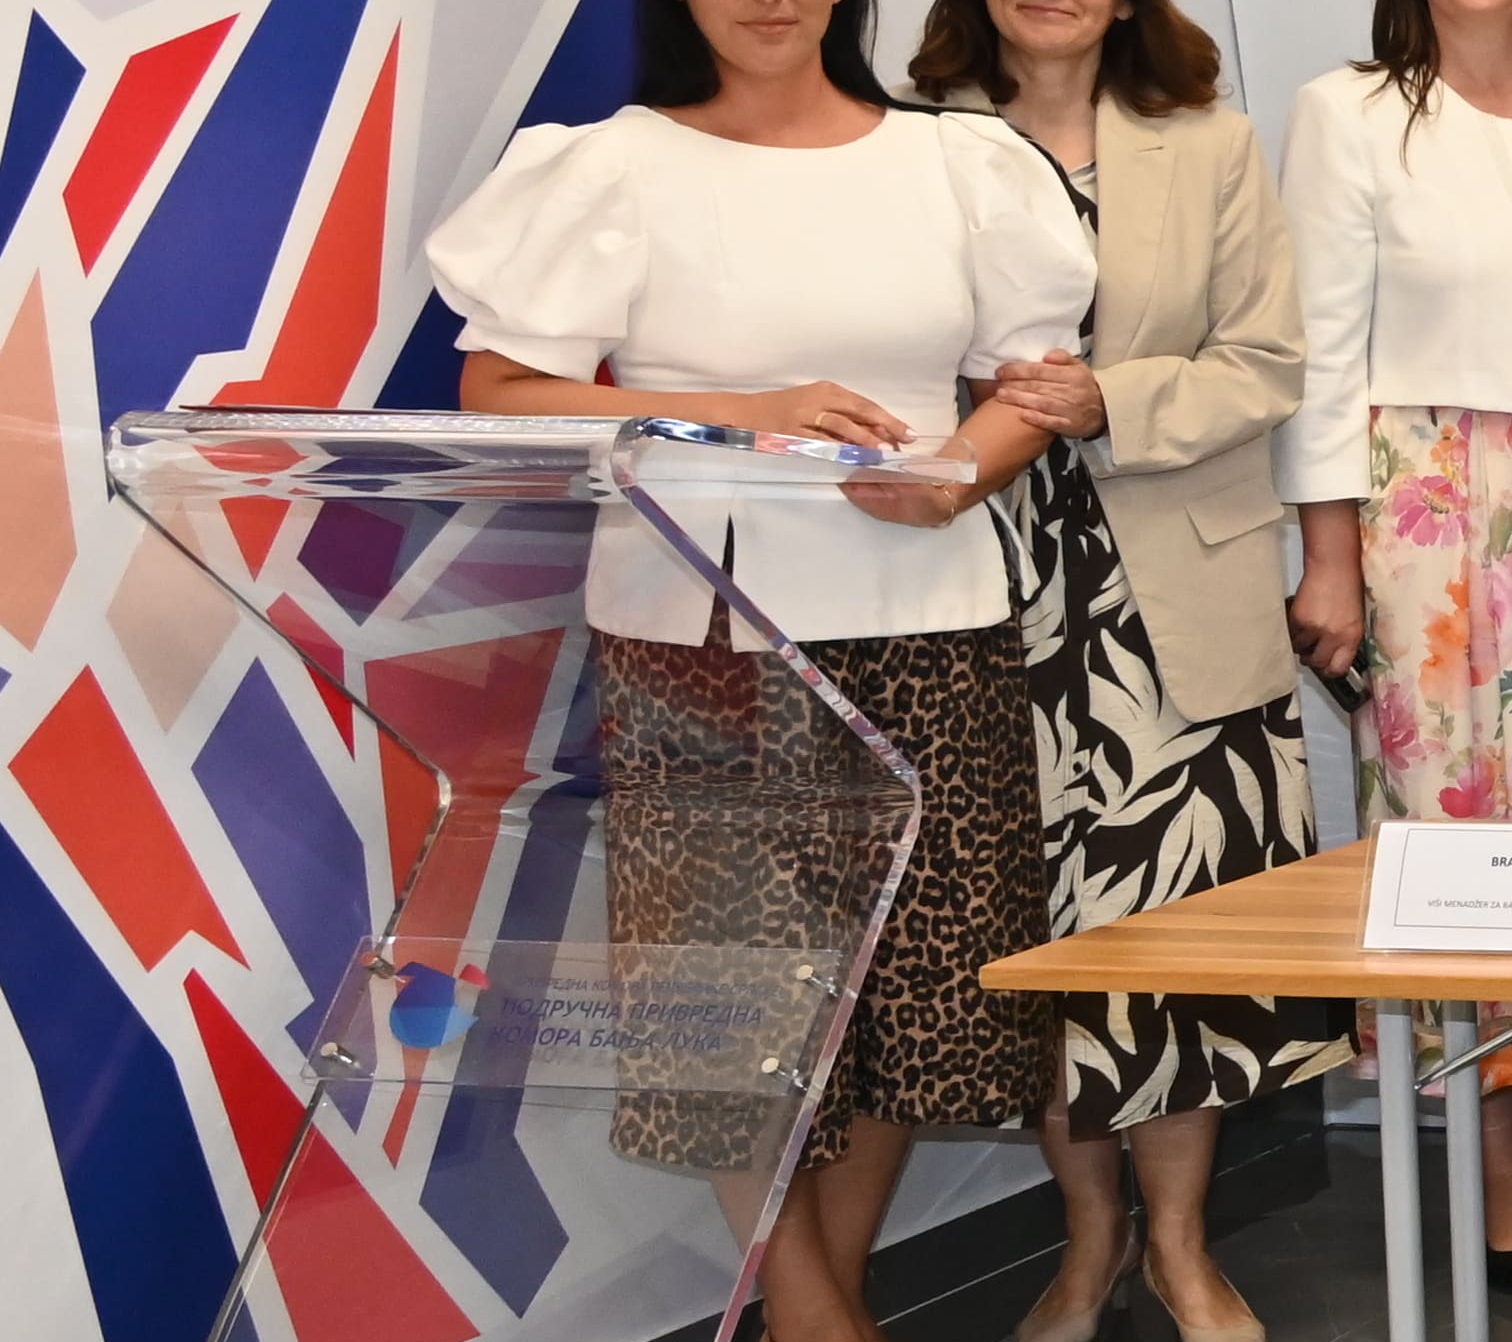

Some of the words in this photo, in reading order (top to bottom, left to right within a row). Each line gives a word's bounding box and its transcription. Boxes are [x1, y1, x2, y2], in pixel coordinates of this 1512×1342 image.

[1490, 900, 1501, 909] ZA
[502, 998, 621, 1021] ПОДРУЧНА
[629, 1002, 764, 1026] ПРИВРЕДНА
[589, 1030, 652, 1051] БАЊА
[662, 1032, 723, 1052] ЛУКА
